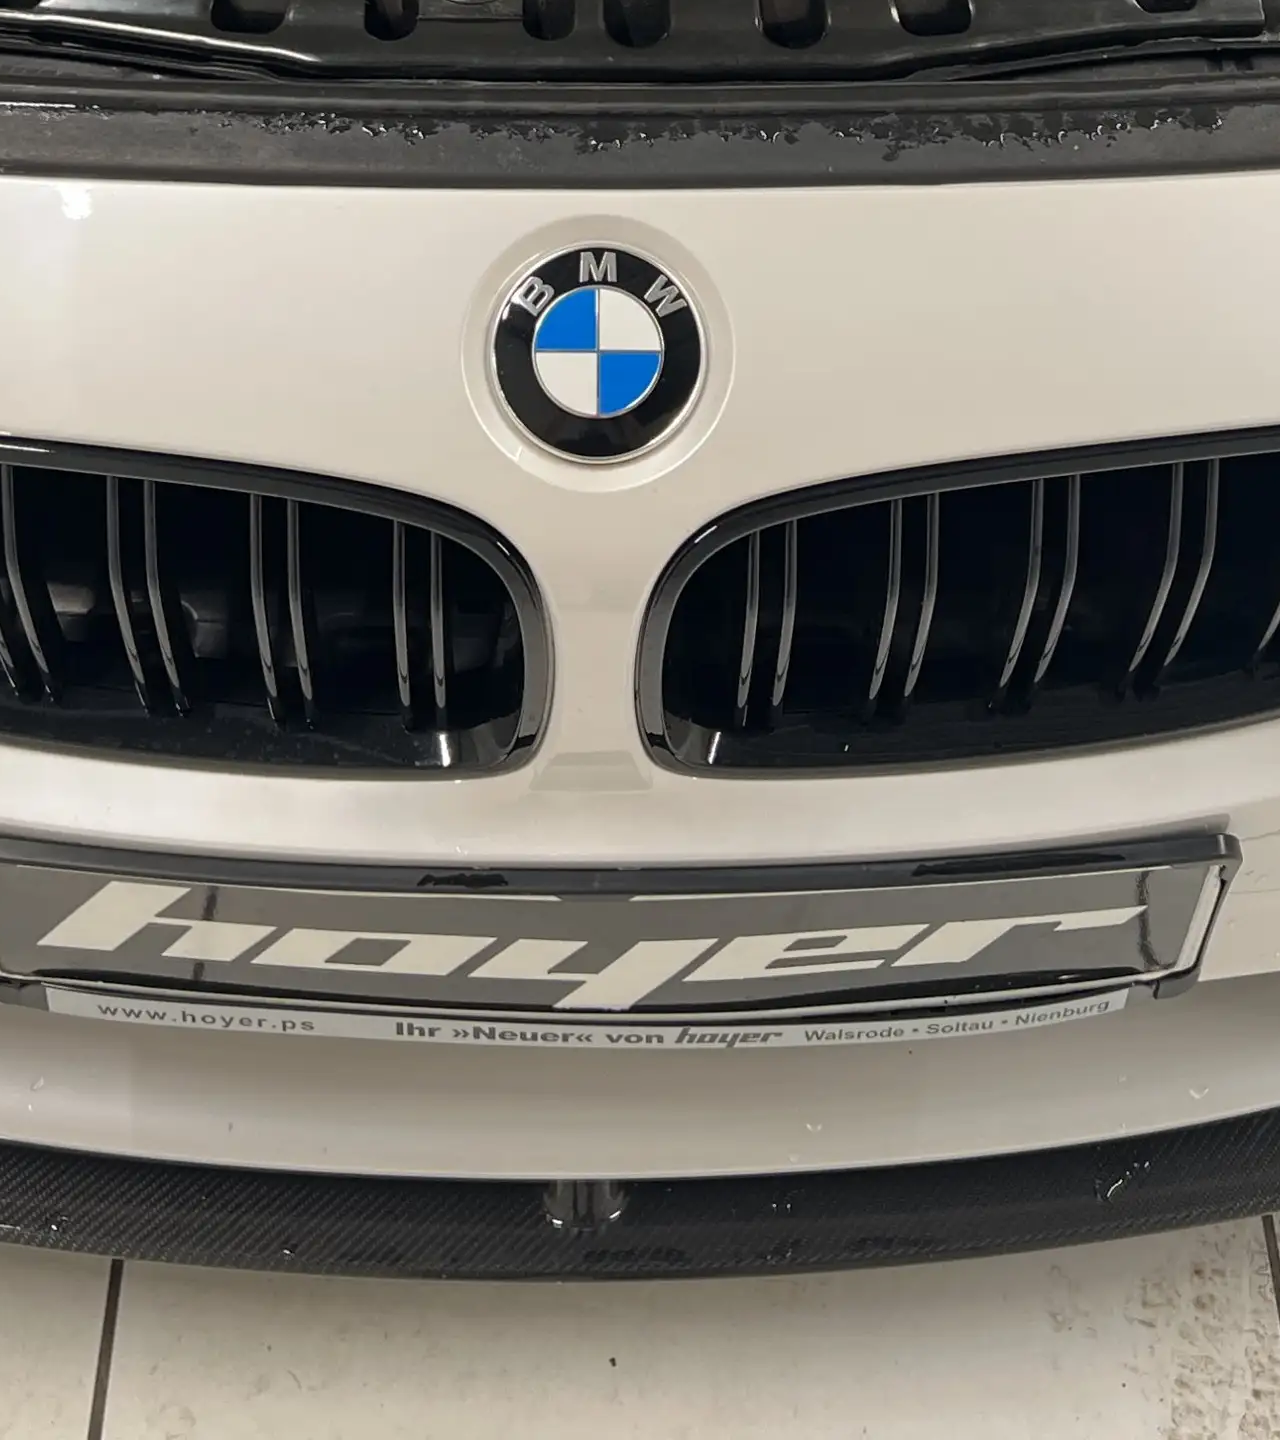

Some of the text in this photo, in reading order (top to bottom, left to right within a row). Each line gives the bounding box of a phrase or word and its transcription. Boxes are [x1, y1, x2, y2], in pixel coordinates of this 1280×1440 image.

[519, 251, 688, 317] BMW
[36, 879, 1148, 1009] hoyer
[97, 1003, 315, 1031] www.hoyer.ps
[395, 1021, 441, 1038] Ihr
[606, 1034, 664, 1044] von
[674, 1025, 783, 1048] hoyer
[804, 1025, 905, 1042] Walsrode
[925, 1020, 994, 1035] Soltau
[1015, 1000, 1110, 1025] Nienburg
